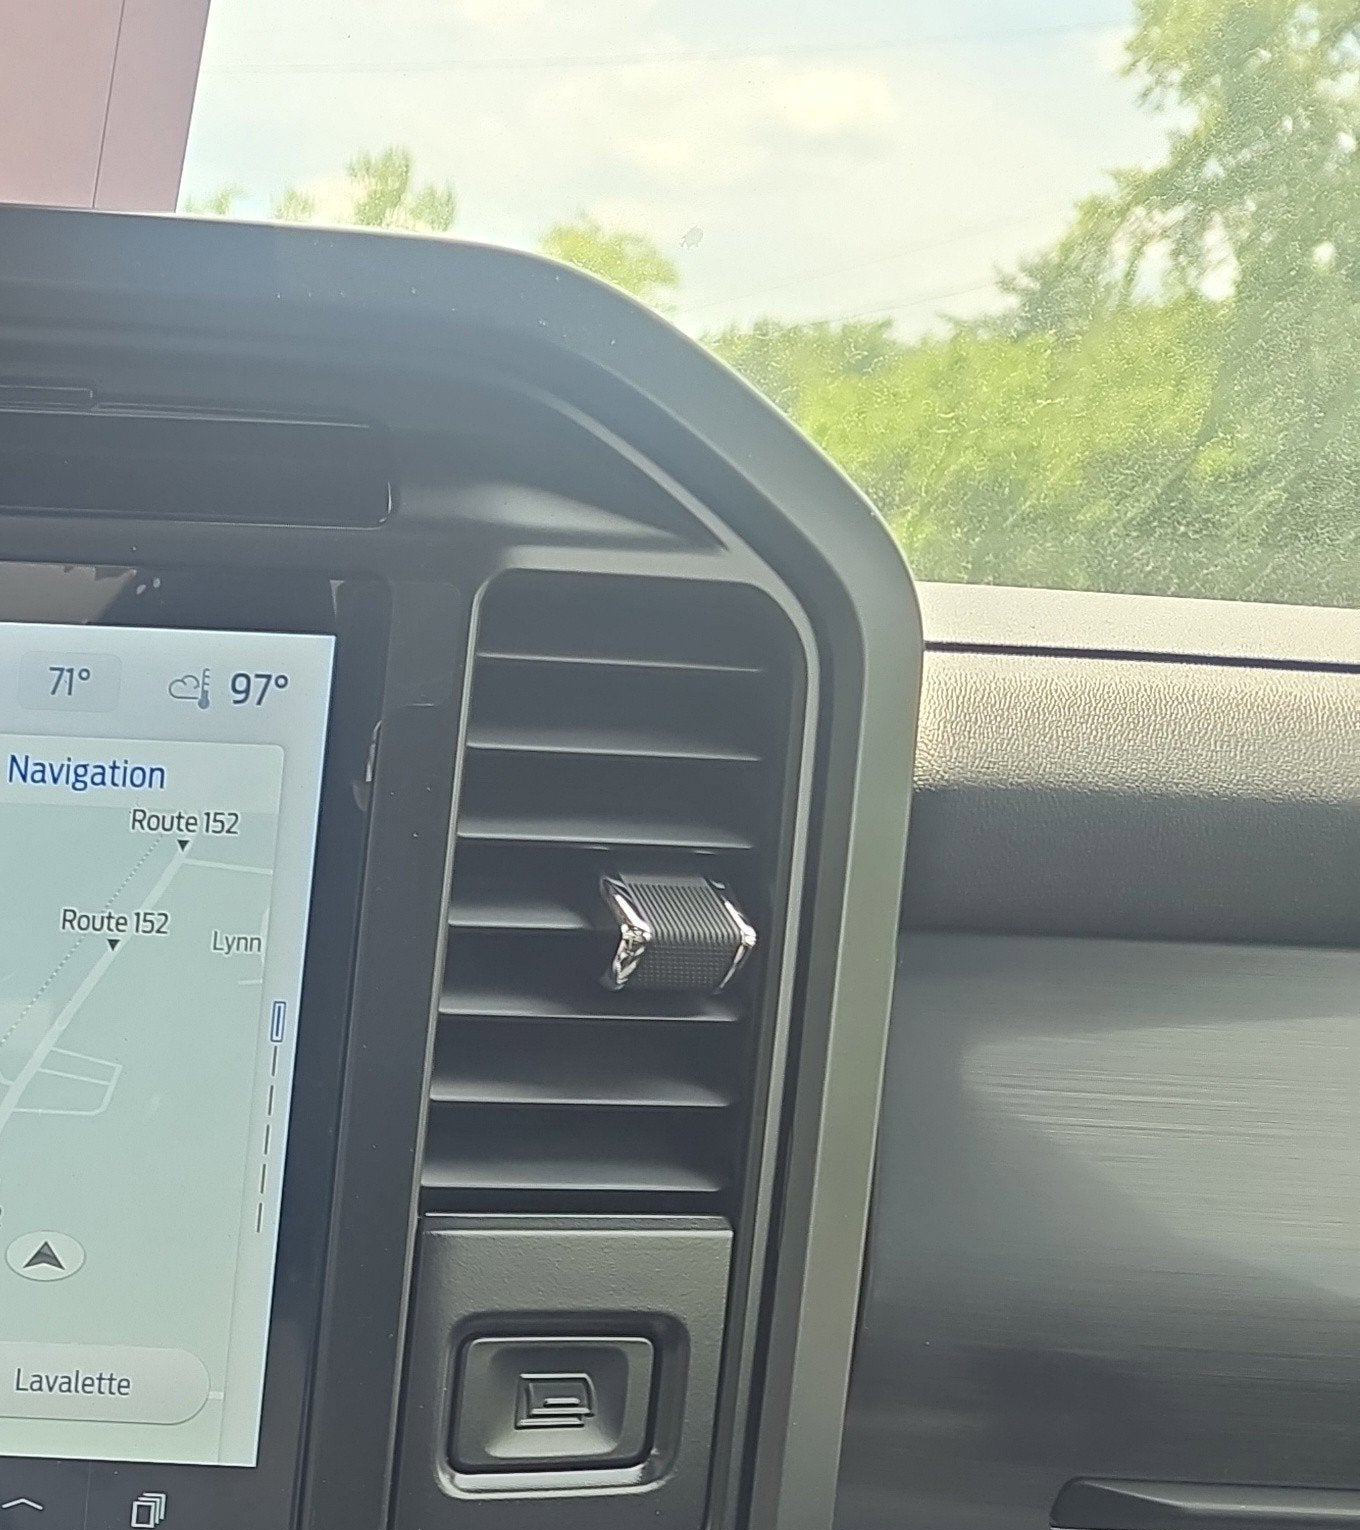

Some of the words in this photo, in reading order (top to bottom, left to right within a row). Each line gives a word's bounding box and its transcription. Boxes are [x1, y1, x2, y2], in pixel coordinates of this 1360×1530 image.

[48, 666, 91, 696] 71°
[230, 673, 289, 706] 97°
[8, 754, 166, 790] Navigation
[131, 809, 198, 834] Route
[203, 811, 240, 835] 152
[61, 909, 129, 933] Route
[134, 911, 170, 934] 152
[212, 931, 262, 955] Lynn
[15, 1368, 132, 1397] Lavalette
